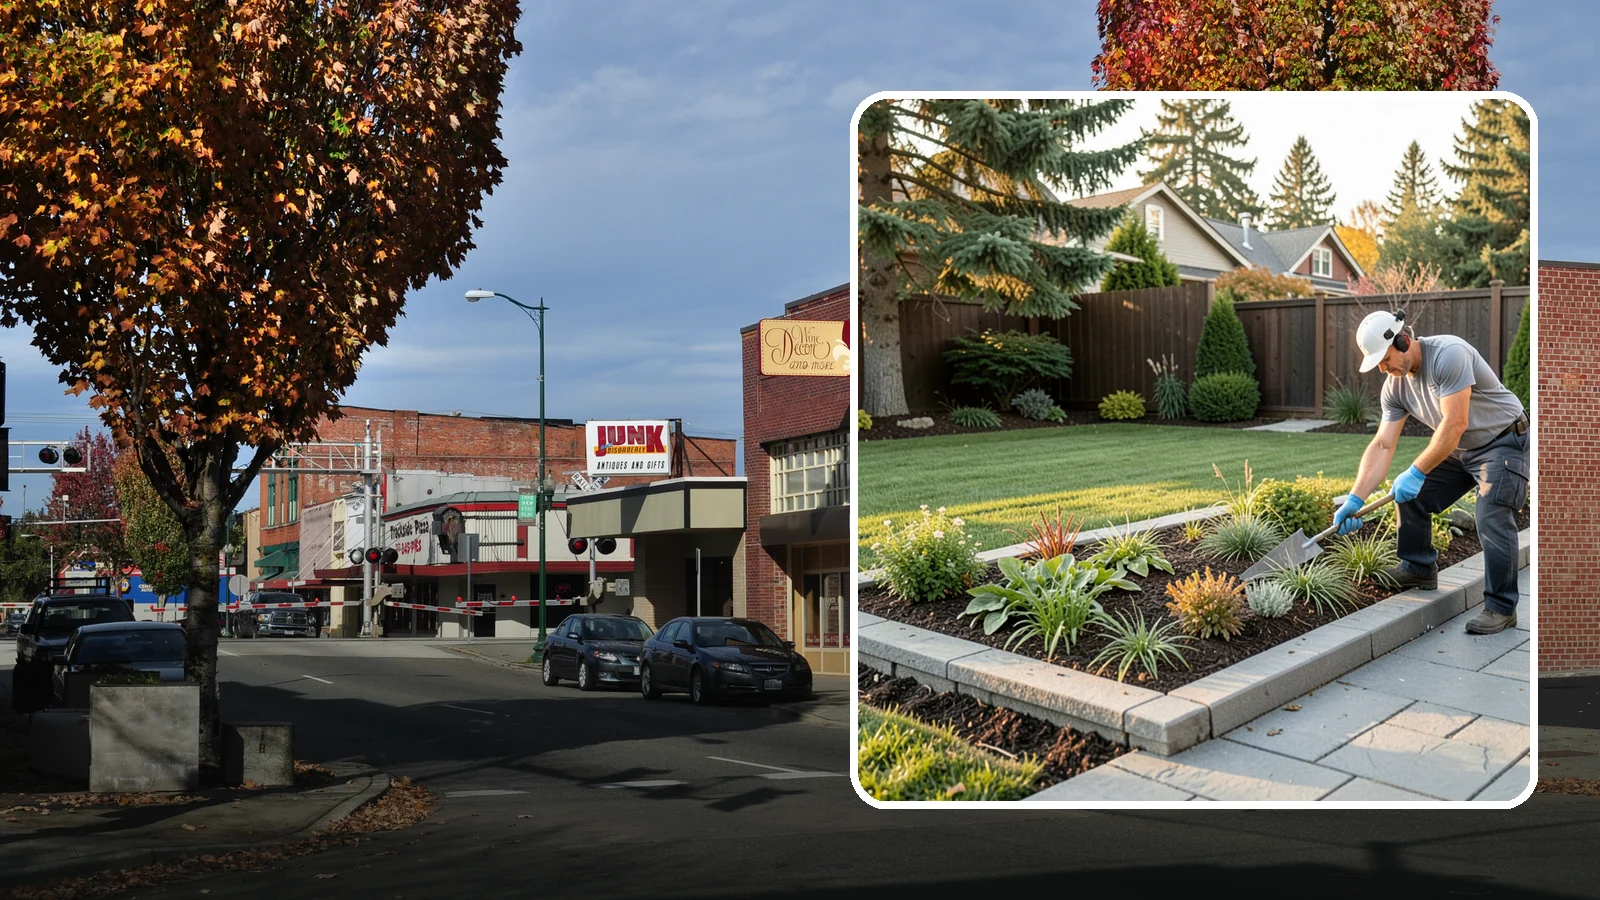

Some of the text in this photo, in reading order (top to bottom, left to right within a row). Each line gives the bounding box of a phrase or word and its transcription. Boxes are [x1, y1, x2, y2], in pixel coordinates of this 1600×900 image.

[595, 425, 665, 457] JUNK
[607, 446, 646, 454] DISORDERLY
[596, 460, 665, 470] ANTIQUES AND GIFTS
[414, 519, 429, 535] Pizza
